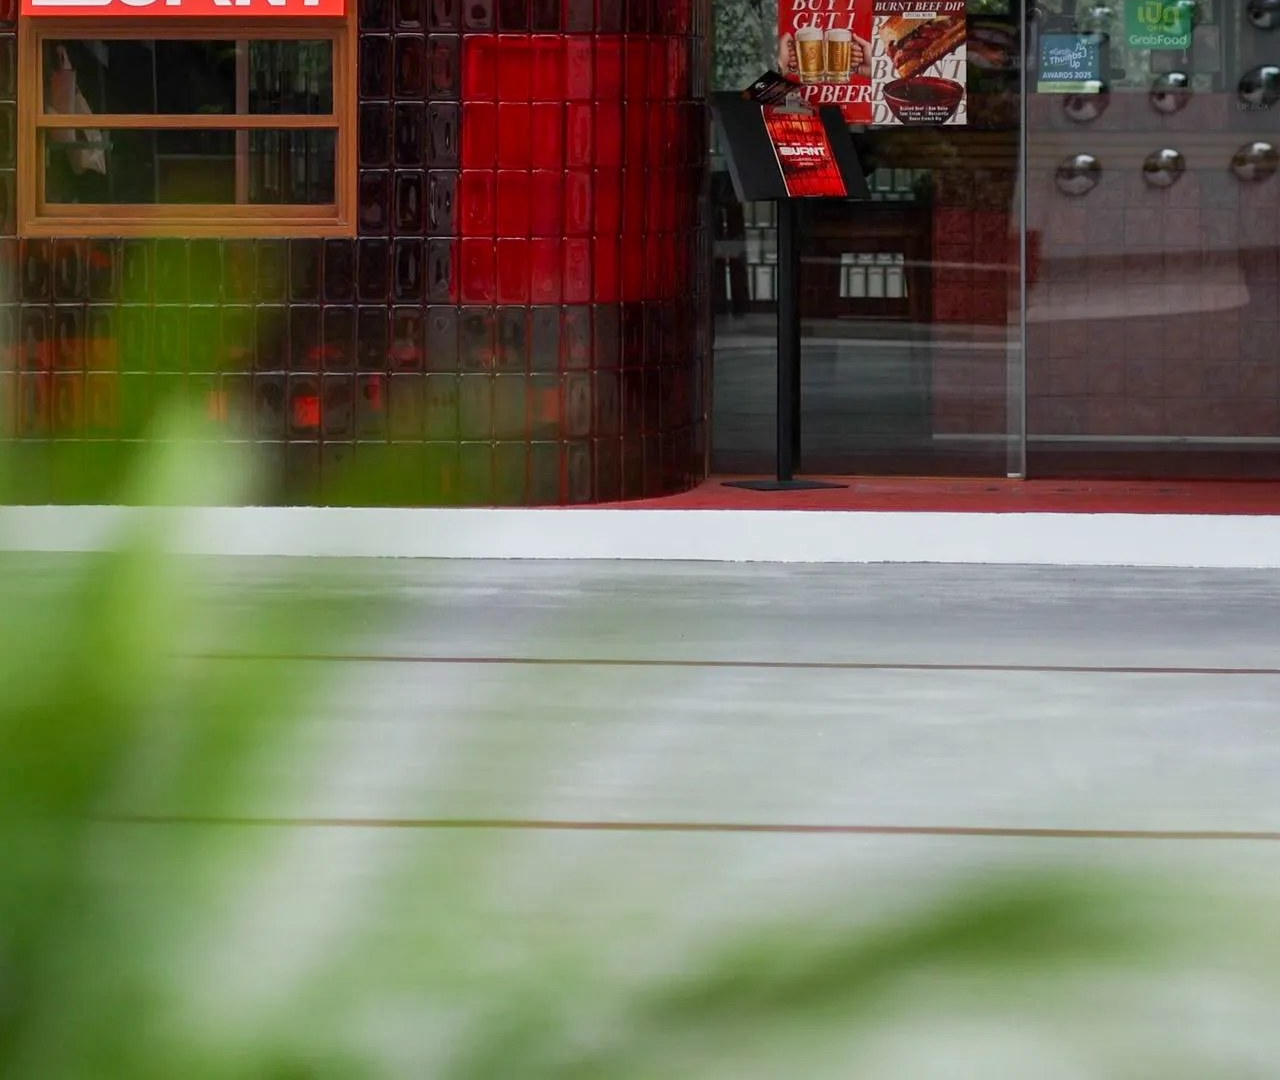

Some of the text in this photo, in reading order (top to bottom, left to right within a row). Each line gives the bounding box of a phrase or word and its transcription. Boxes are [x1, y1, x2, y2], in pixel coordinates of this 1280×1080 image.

[875, 1, 965, 12] BURNT BEEF DIP
[792, 12, 842, 30] GET
[847, 12, 857, 30] 1
[1129, 34, 1188, 46] GrabFood
[1049, 51, 1082, 65] Thumbs
[1069, 59, 1081, 69] Up
[1042, 71, 1092, 79] AWARDS 2025
[819, 84, 871, 103] BEER
[779, 146, 826, 156] BURNT
